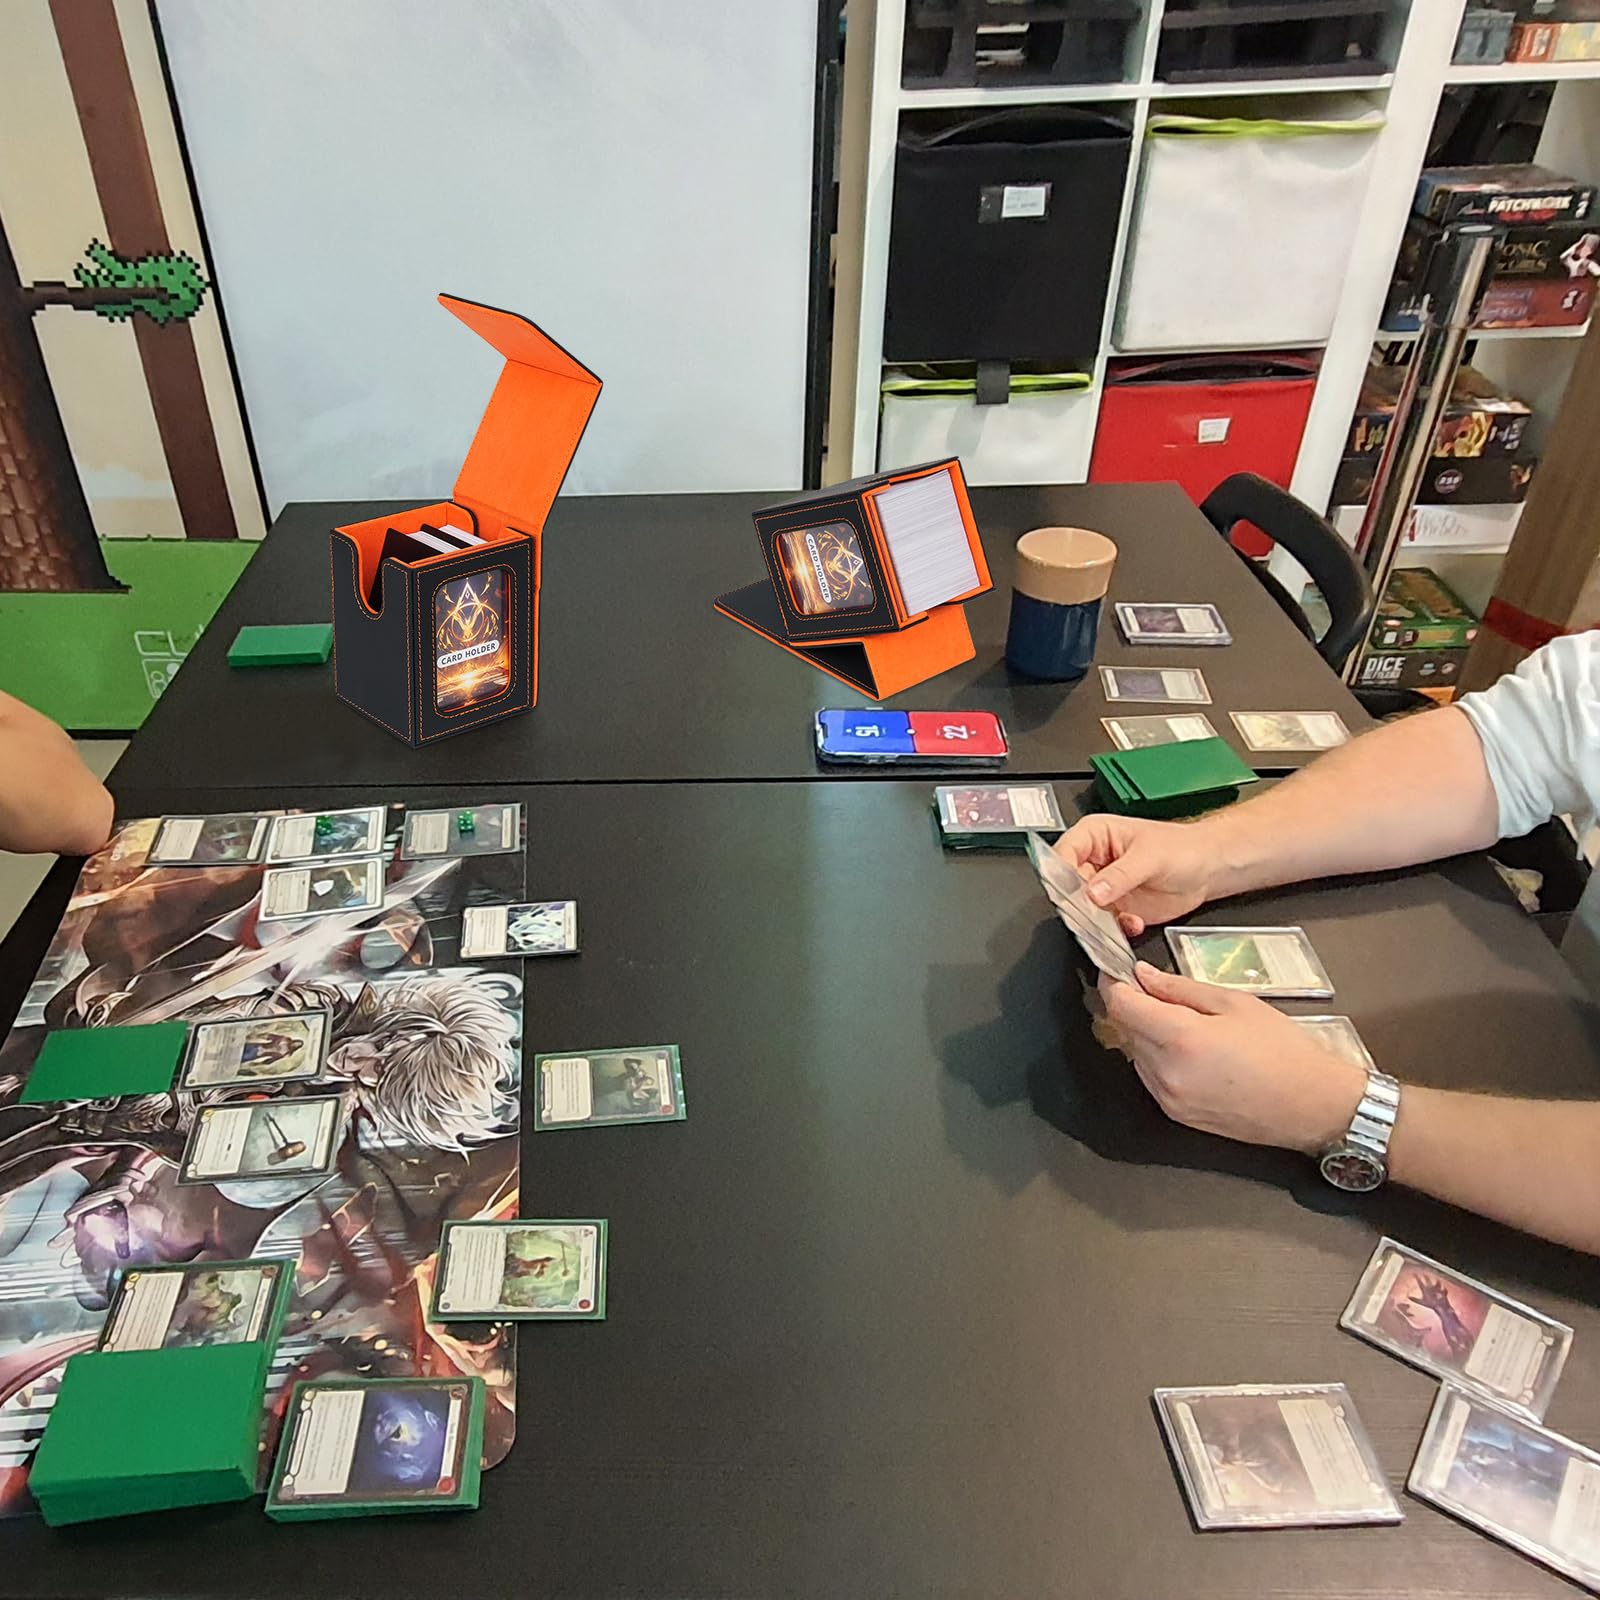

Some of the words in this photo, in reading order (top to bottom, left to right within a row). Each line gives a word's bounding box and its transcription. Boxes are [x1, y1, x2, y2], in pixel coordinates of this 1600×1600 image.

[808, 538, 819, 562] CARD
[816, 564, 830, 599] HOLDER
[441, 653, 463, 665] CARD
[465, 642, 497, 658] HOLDER
[1364, 656, 1406, 672] DICE
[855, 725, 880, 738] 15
[942, 725, 969, 740] 22
